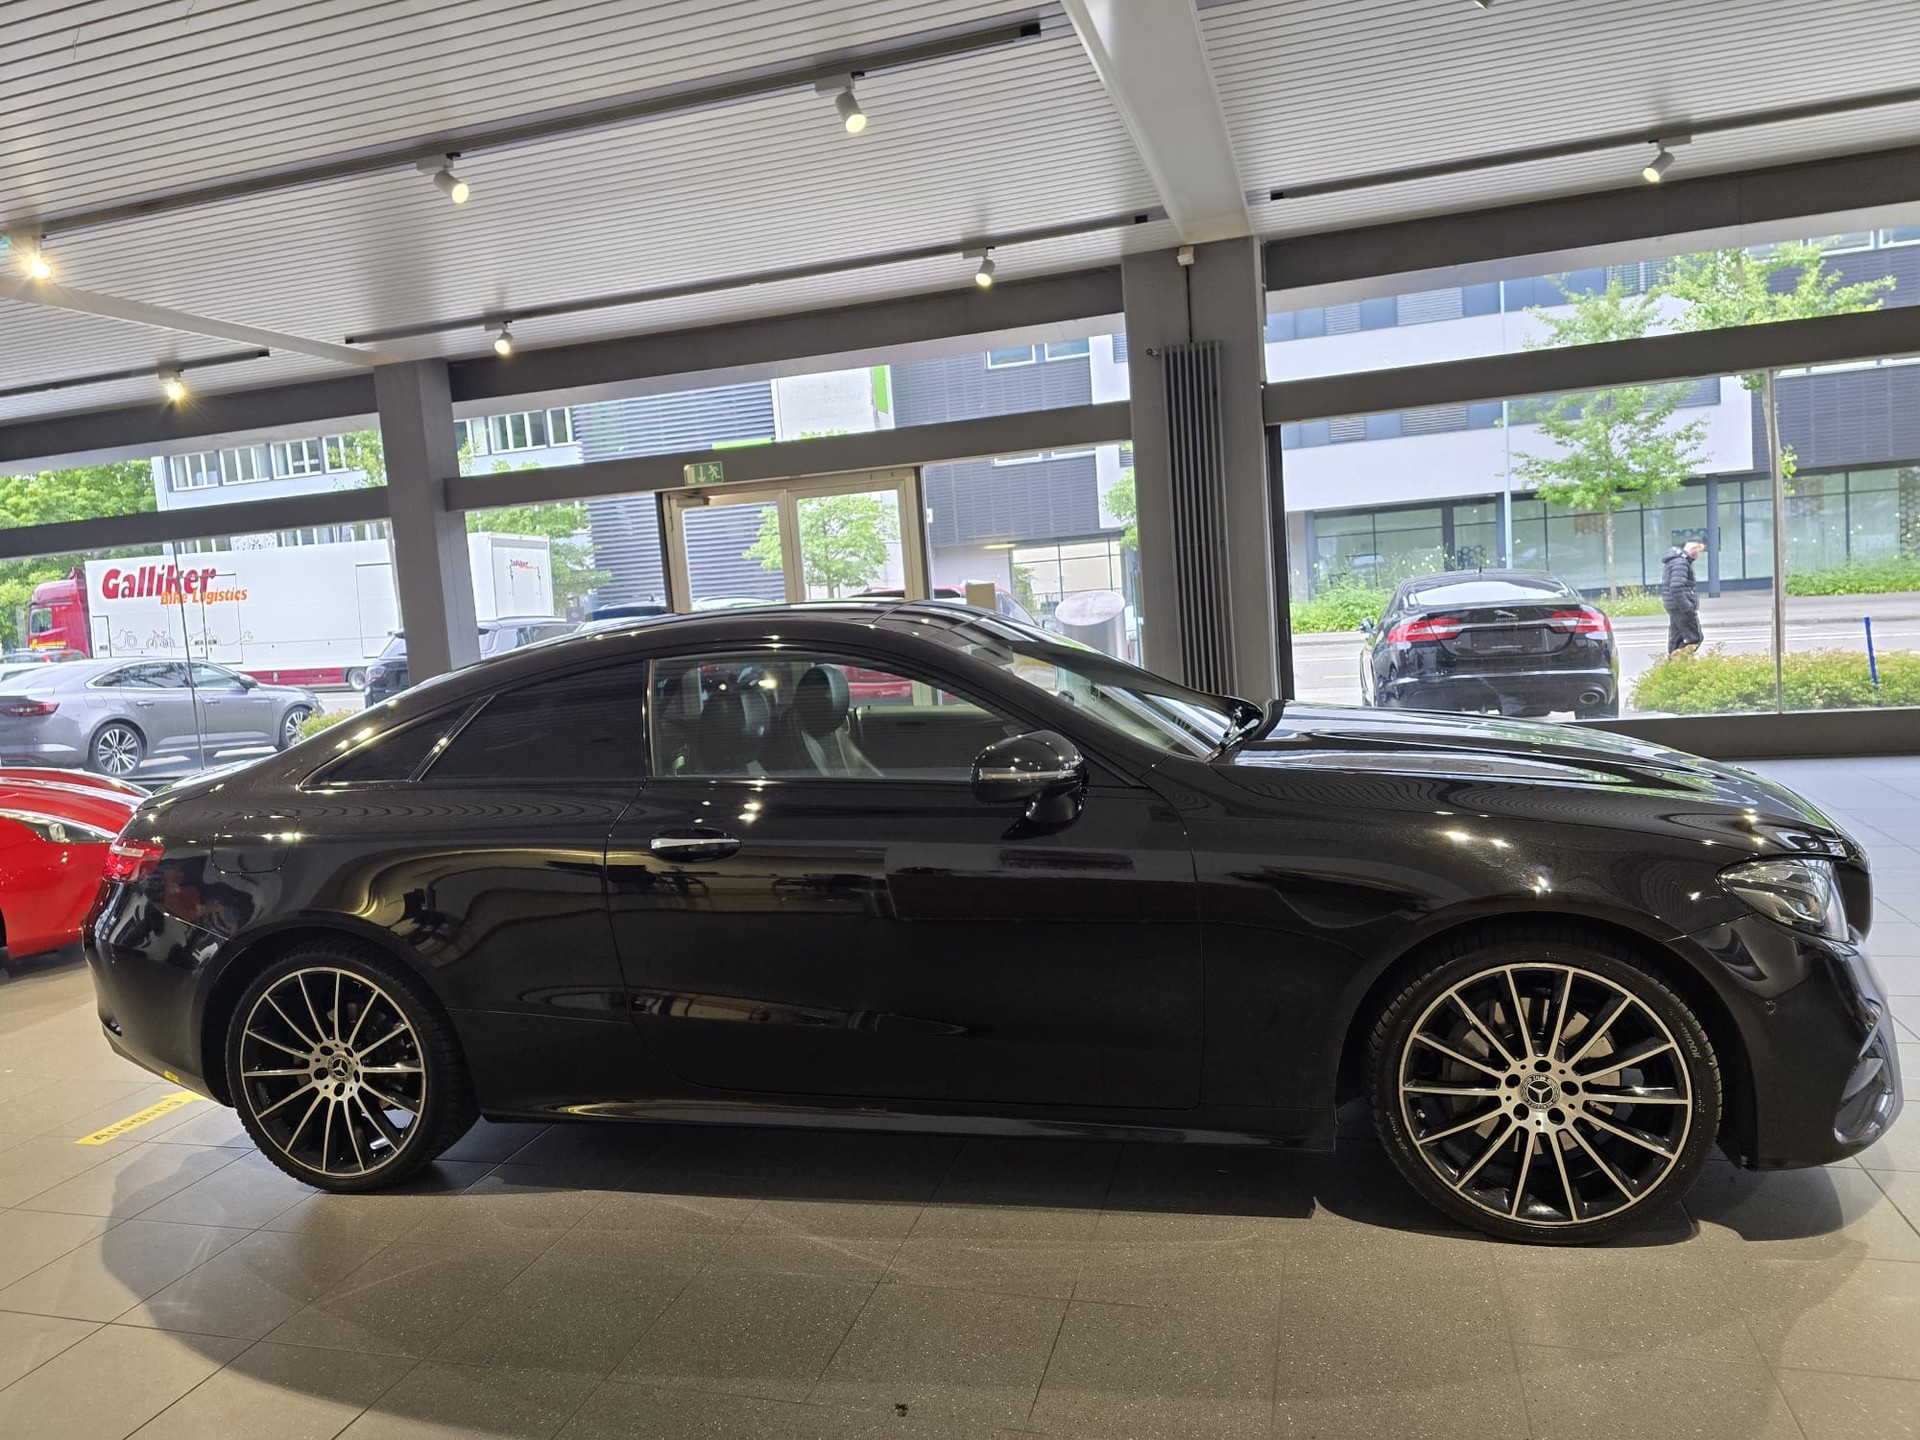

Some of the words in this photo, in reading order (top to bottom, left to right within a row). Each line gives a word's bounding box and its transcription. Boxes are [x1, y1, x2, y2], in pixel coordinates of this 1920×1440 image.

[102, 564, 217, 599] Galliker
[192, 587, 248, 605] Logistics
[93, 1100, 183, 1141] Ausgang
